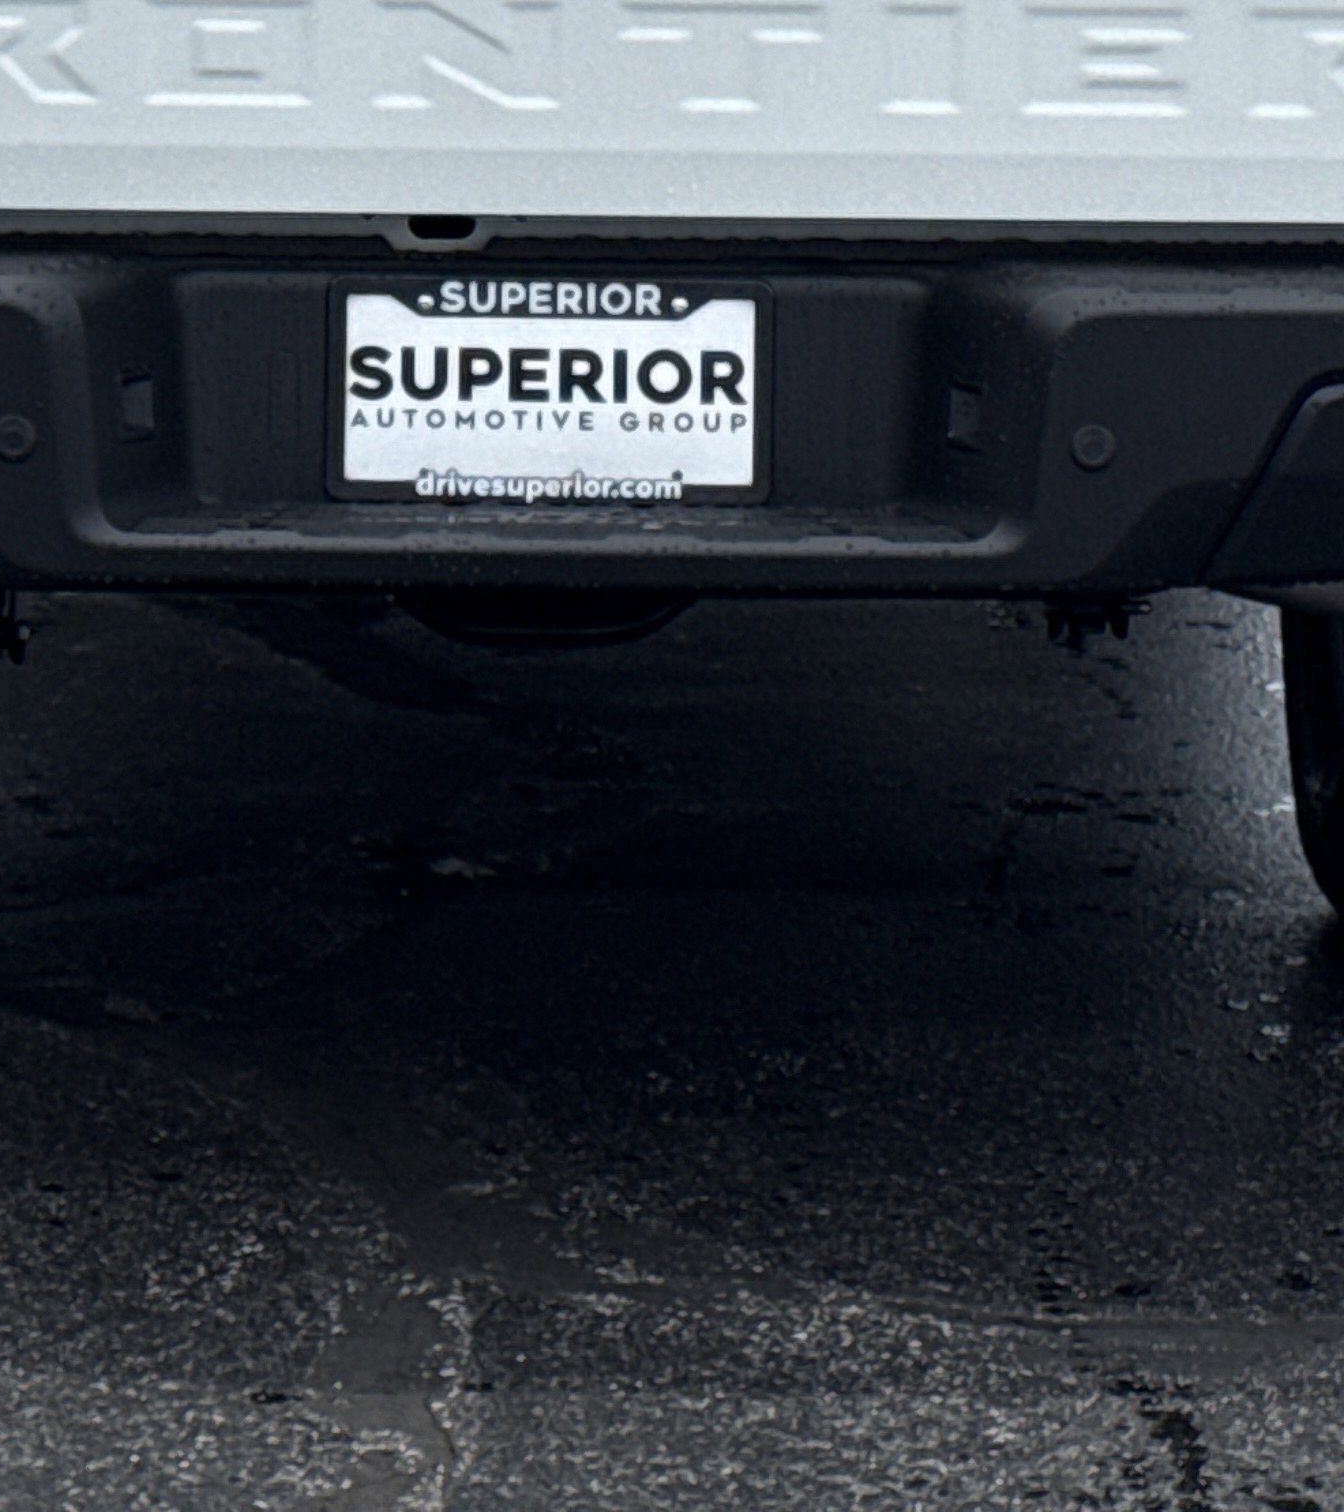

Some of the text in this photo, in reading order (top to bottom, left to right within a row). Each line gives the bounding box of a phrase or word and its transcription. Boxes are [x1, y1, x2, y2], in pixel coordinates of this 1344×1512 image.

[439, 280, 662, 316] SUPERIOR
[349, 345, 748, 406] SUPERIOR
[350, 408, 748, 434] AUTOMOTIVE GROUP
[414, 469, 683, 505] drivesuperior.com
